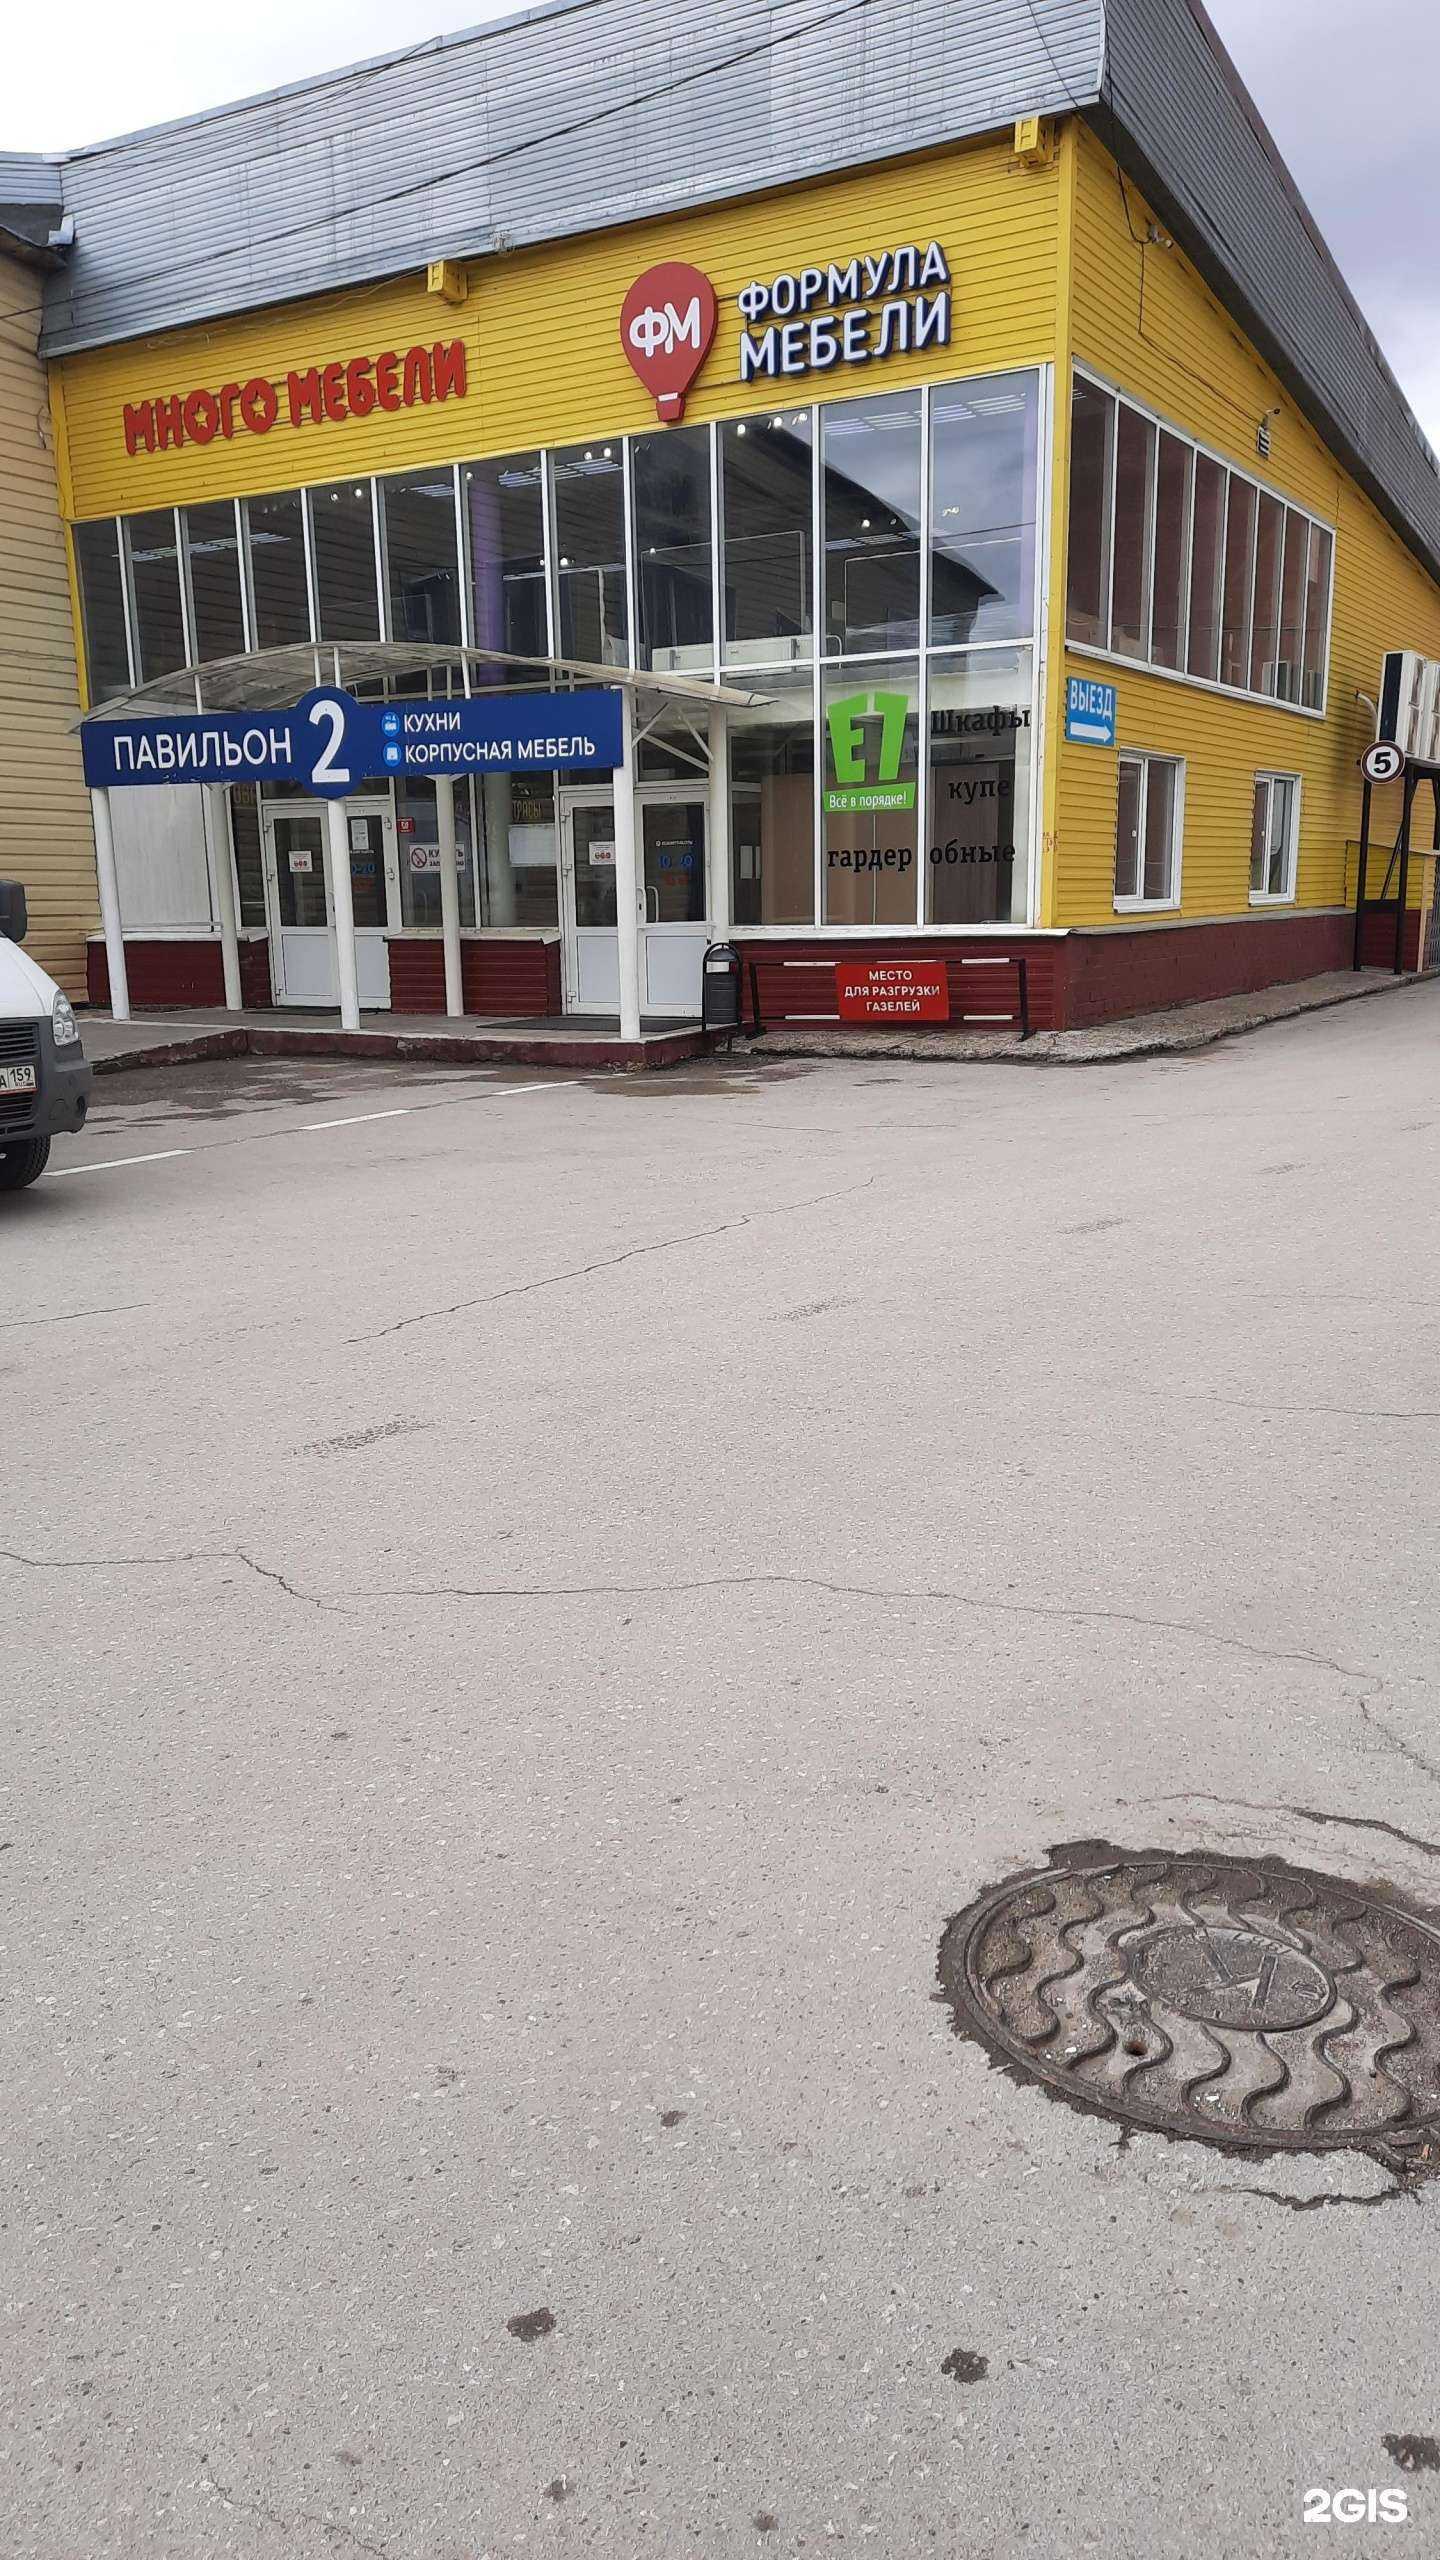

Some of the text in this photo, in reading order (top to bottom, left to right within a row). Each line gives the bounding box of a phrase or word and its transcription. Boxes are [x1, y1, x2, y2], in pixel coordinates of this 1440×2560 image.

[738, 240, 950, 320] ФОРМУЛА
[629, 296, 700, 358] ФМ
[739, 291, 950, 382] МЕБЕЛИ
[122, 337, 467, 457] МНОГО МЕБЕЛИ
[1070, 679, 1113, 721] ВЫЕЗД
[404, 711, 461, 733] КУХНИ
[930, 705, 1031, 737] Шкафы
[113, 699, 350, 784] ПАВИЛЬОН 2
[405, 736, 596, 764] КОРПУСНАЯ МЕБЕЛЬ
[1373, 751, 1391, 774] 5
[829, 791, 907, 808] Всё в порядке!
[948, 778, 1012, 805] купе
[827, 847, 912, 872] гардер
[929, 838, 1015, 865] обные
[868, 970, 912, 981] МЕСТО
[844, 985, 940, 998] ДЛЯ РАЗГРУЗКИ
[866, 999, 920, 1012] ГАЗЕЛЕЙ
[10, 1067, 31, 1082] 159
